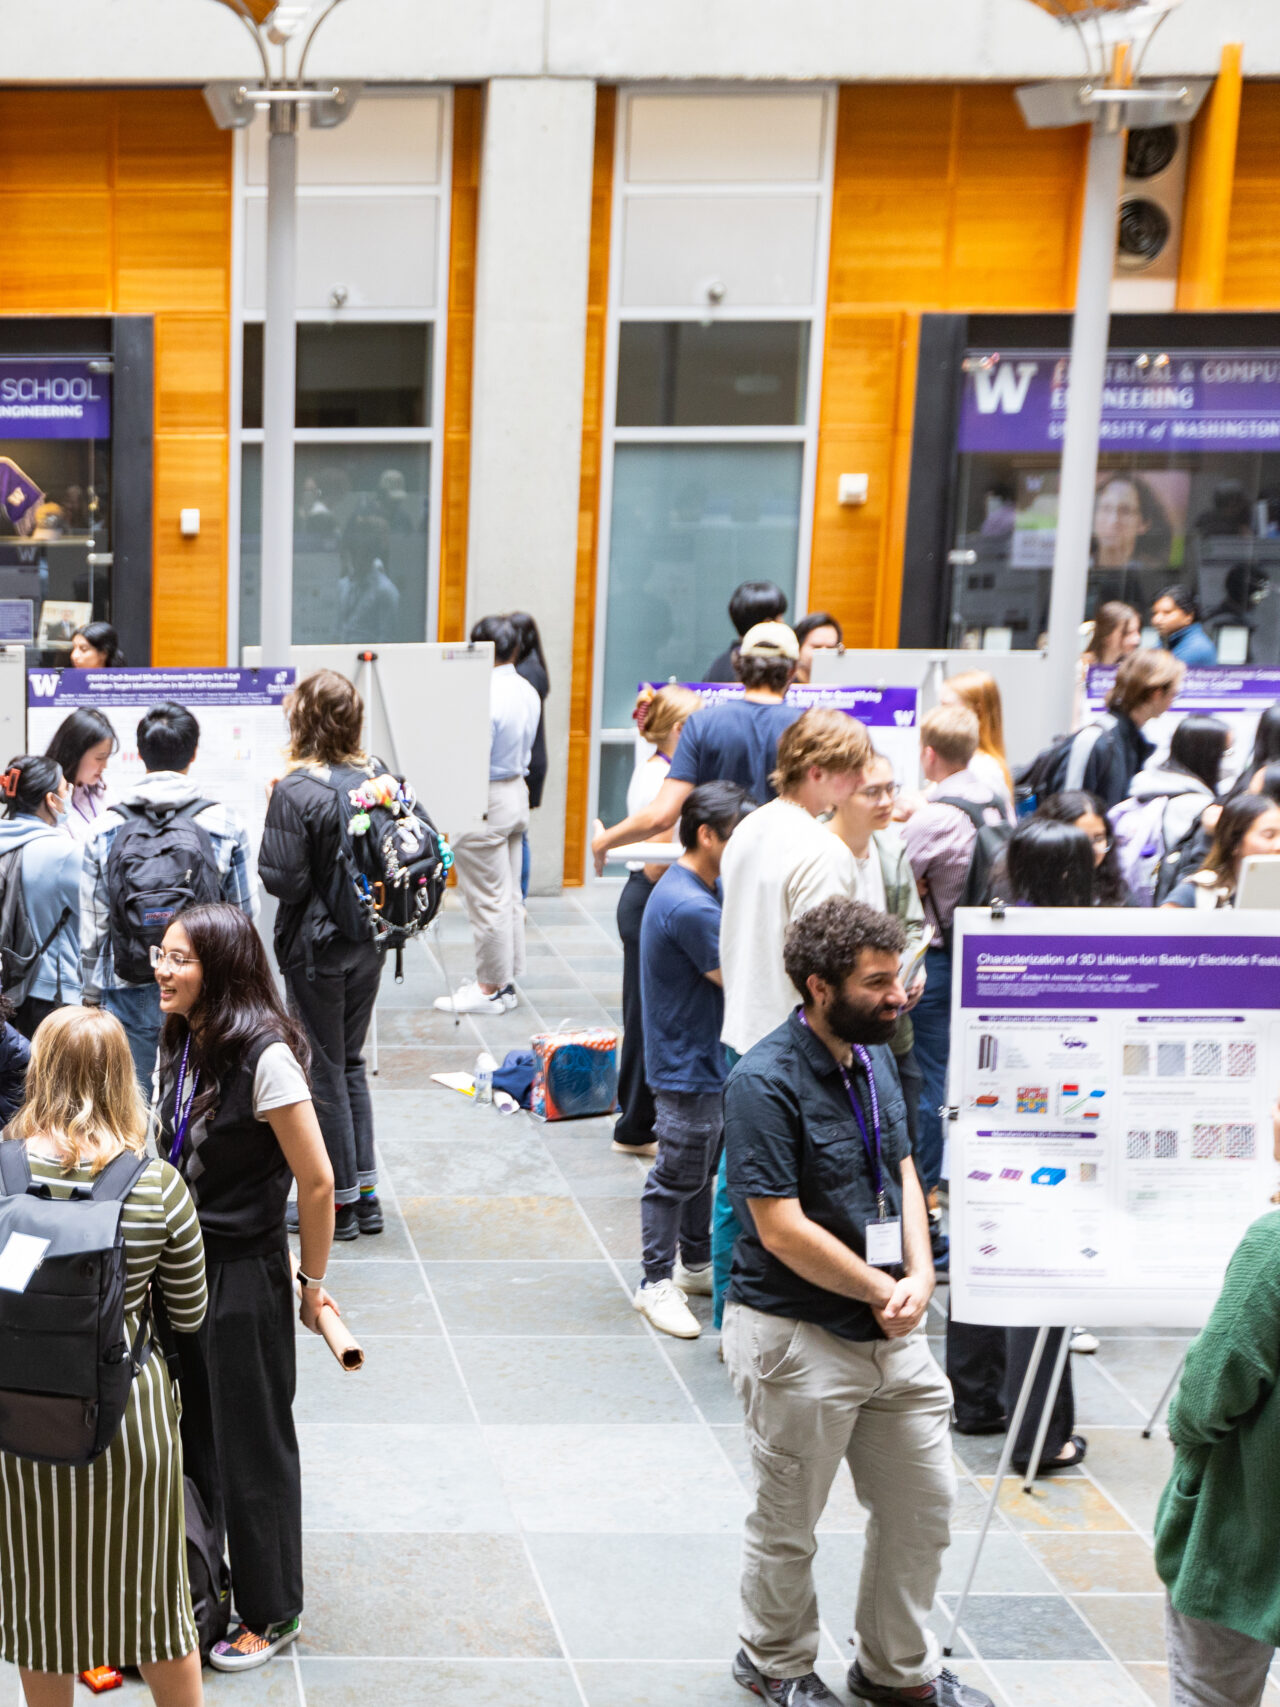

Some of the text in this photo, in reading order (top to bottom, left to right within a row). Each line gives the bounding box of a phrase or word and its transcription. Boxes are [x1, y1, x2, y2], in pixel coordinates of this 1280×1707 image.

[1, 378, 101, 401] SCHOOL
[28, 673, 61, 698] W
[893, 709, 915, 727] W
[976, 952, 1065, 966] Characterization
[1065, 953, 1078, 966] of
[1079, 953, 1097, 966] 3D
[1158, 953, 1198, 968] Battery
